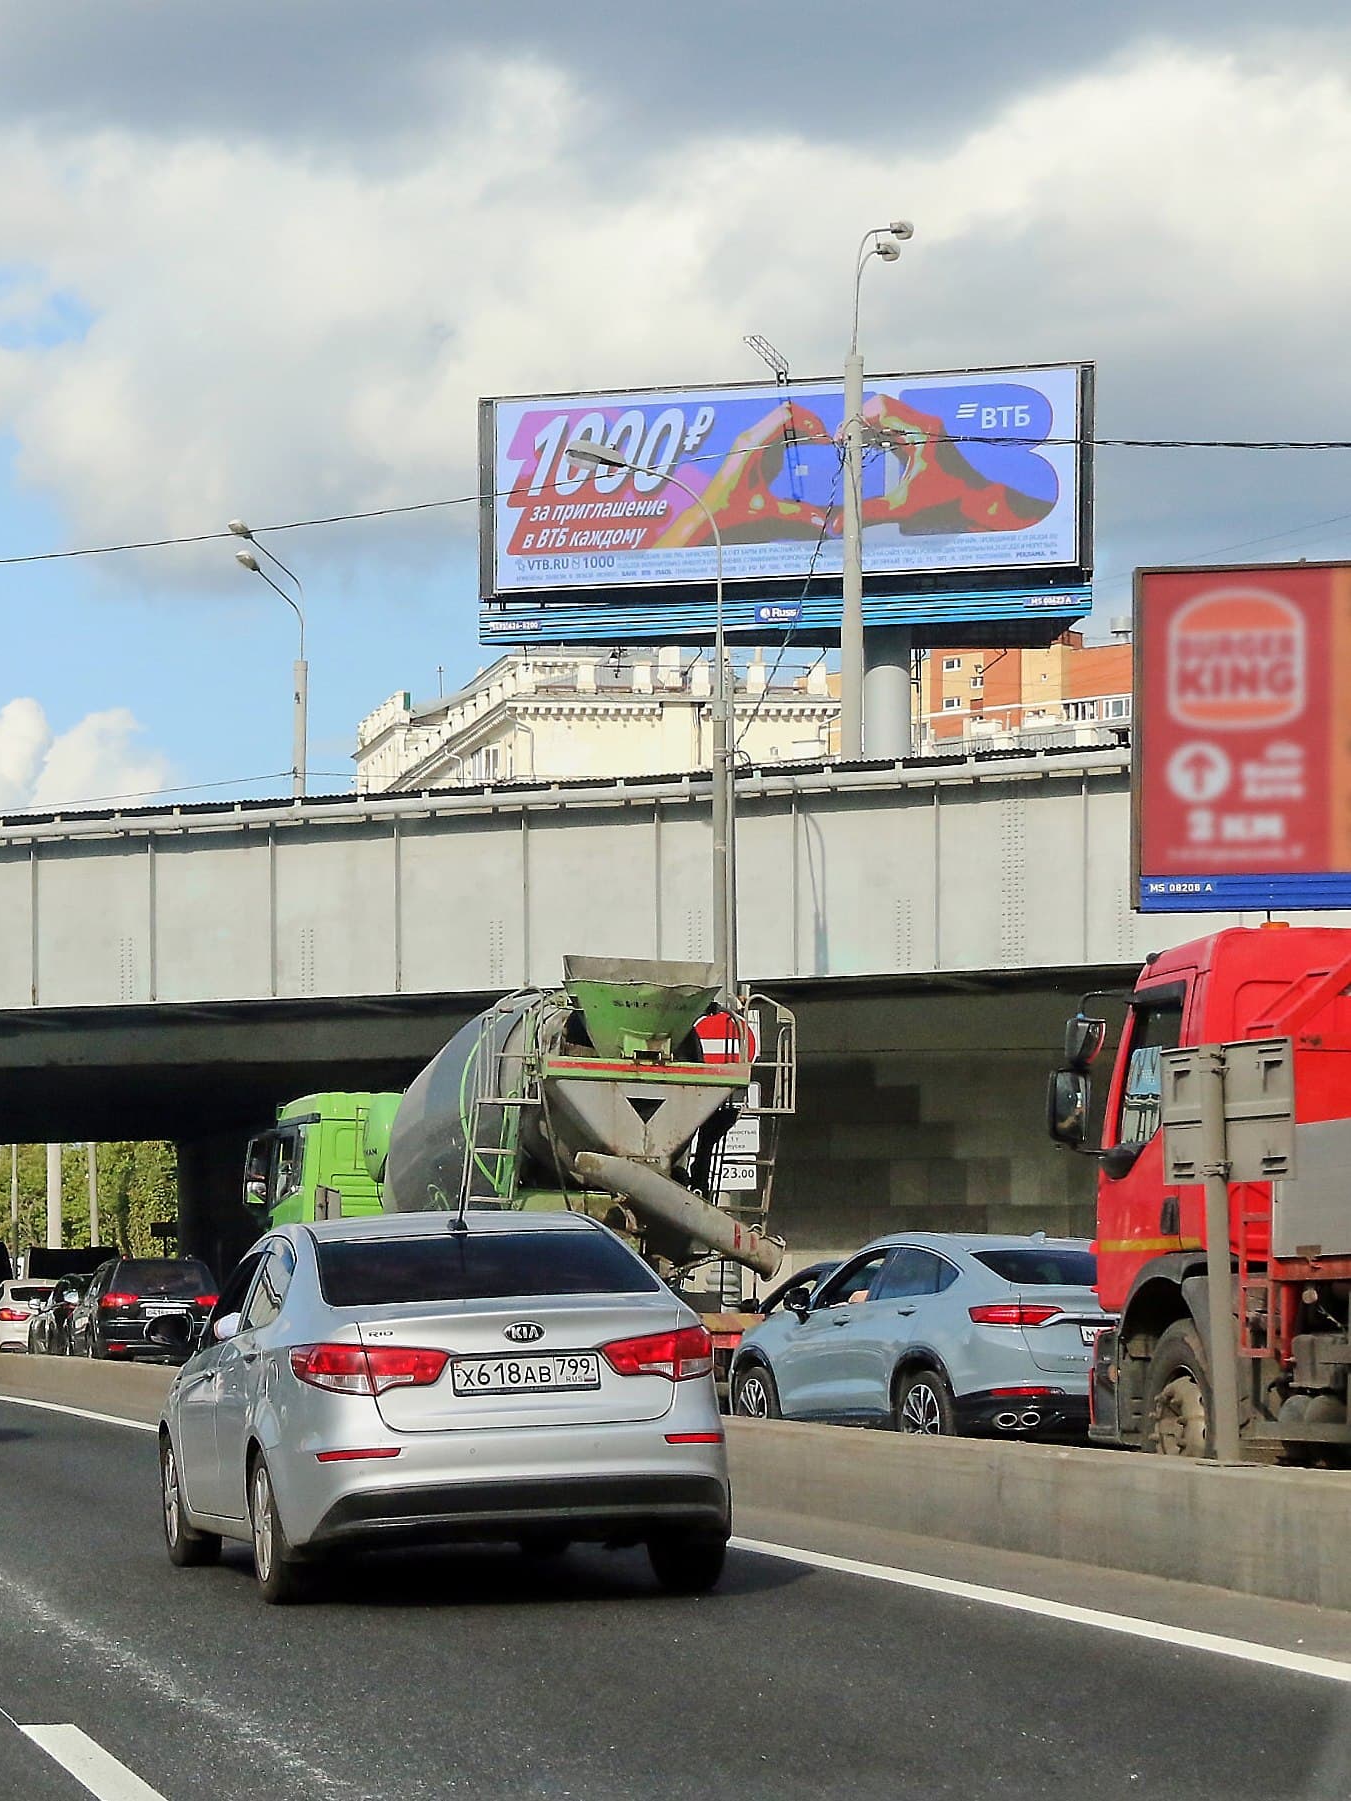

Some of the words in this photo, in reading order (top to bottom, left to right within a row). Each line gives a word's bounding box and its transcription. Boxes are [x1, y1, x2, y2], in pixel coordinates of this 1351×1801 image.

[981, 405, 1030, 429] ВТБ
[530, 504, 547, 522] за
[551, 499, 668, 525] приглашение
[522, 533, 534, 549] в
[536, 528, 569, 549] ВТБ
[570, 527, 647, 549] каждому
[527, 558, 569, 571] VTB.RU
[582, 555, 615, 569] 1000
[1176, 659, 1296, 697] KING
[1149, 883, 1165, 892] MS
[1205, 883, 1212, 891] A
[722, 1167, 755, 1179] 23.00
[511, 1326, 539, 1339] KIA
[463, 1362, 552, 1387] Х618АВ
[555, 1358, 591, 1376] 799
[565, 1375, 583, 1383] RUS
